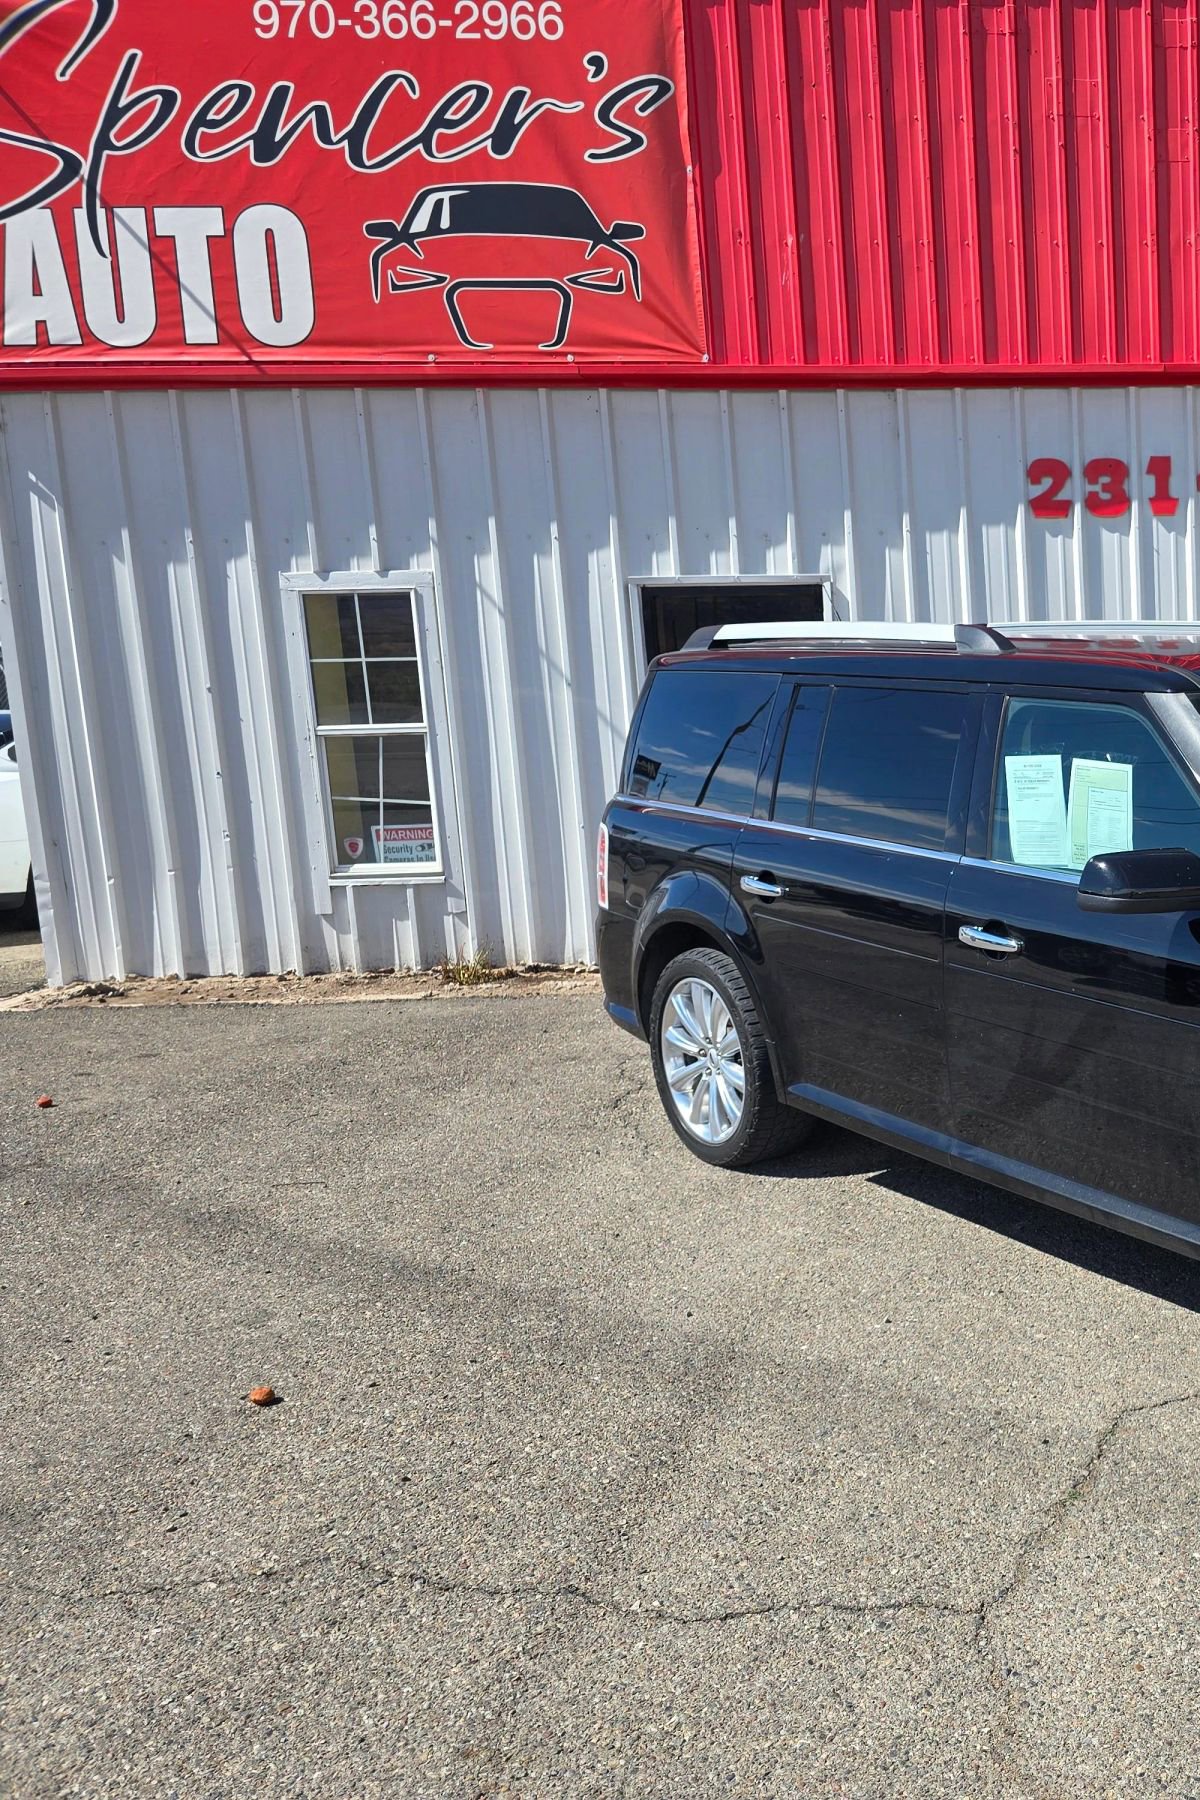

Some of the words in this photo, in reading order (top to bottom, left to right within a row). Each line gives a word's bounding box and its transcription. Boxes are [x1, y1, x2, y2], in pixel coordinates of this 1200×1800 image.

[252, 0, 564, 40] 970-366-2966
[0, 0, 674, 260] Spencer's
[2, 204, 315, 348] AUTO
[383, 843, 413, 855] Security
